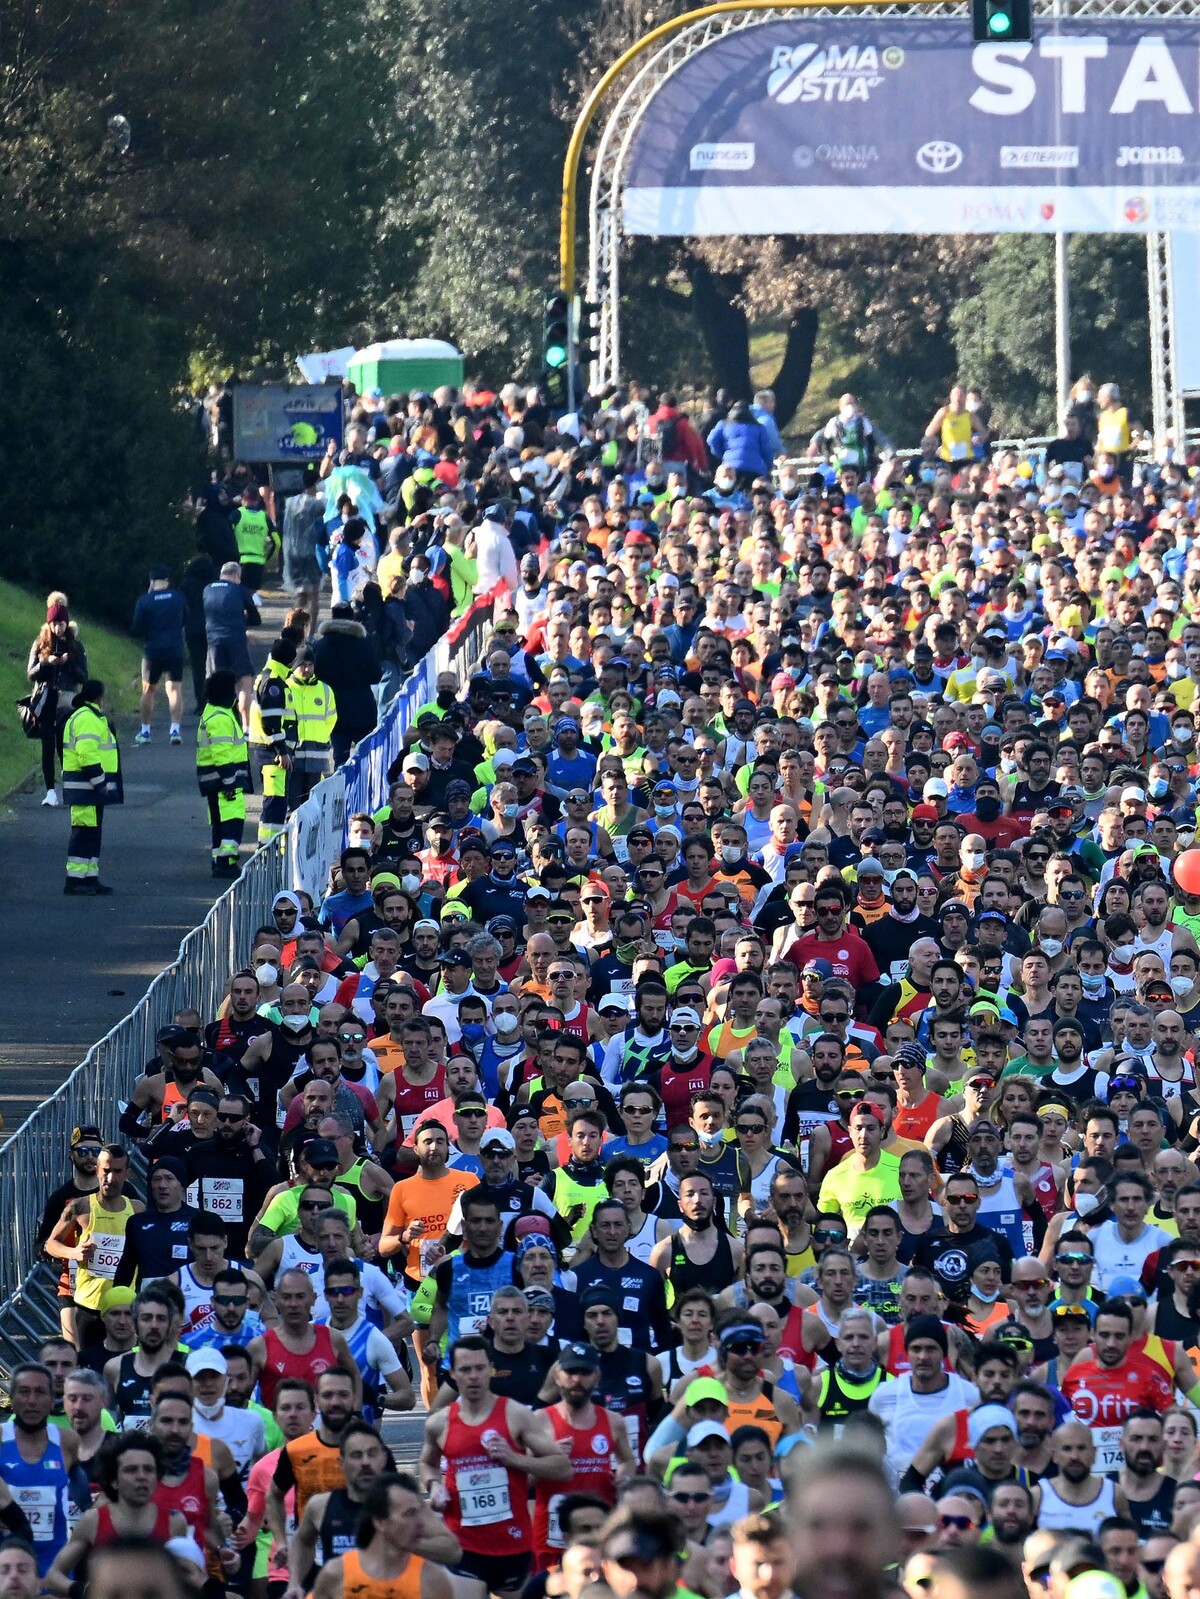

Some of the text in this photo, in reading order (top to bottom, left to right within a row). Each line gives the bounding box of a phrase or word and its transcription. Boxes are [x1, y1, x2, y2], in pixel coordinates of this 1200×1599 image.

[211, 1198, 232, 1209] 862
[97, 1253, 120, 1267] 502
[472, 1495, 497, 1509] 168
